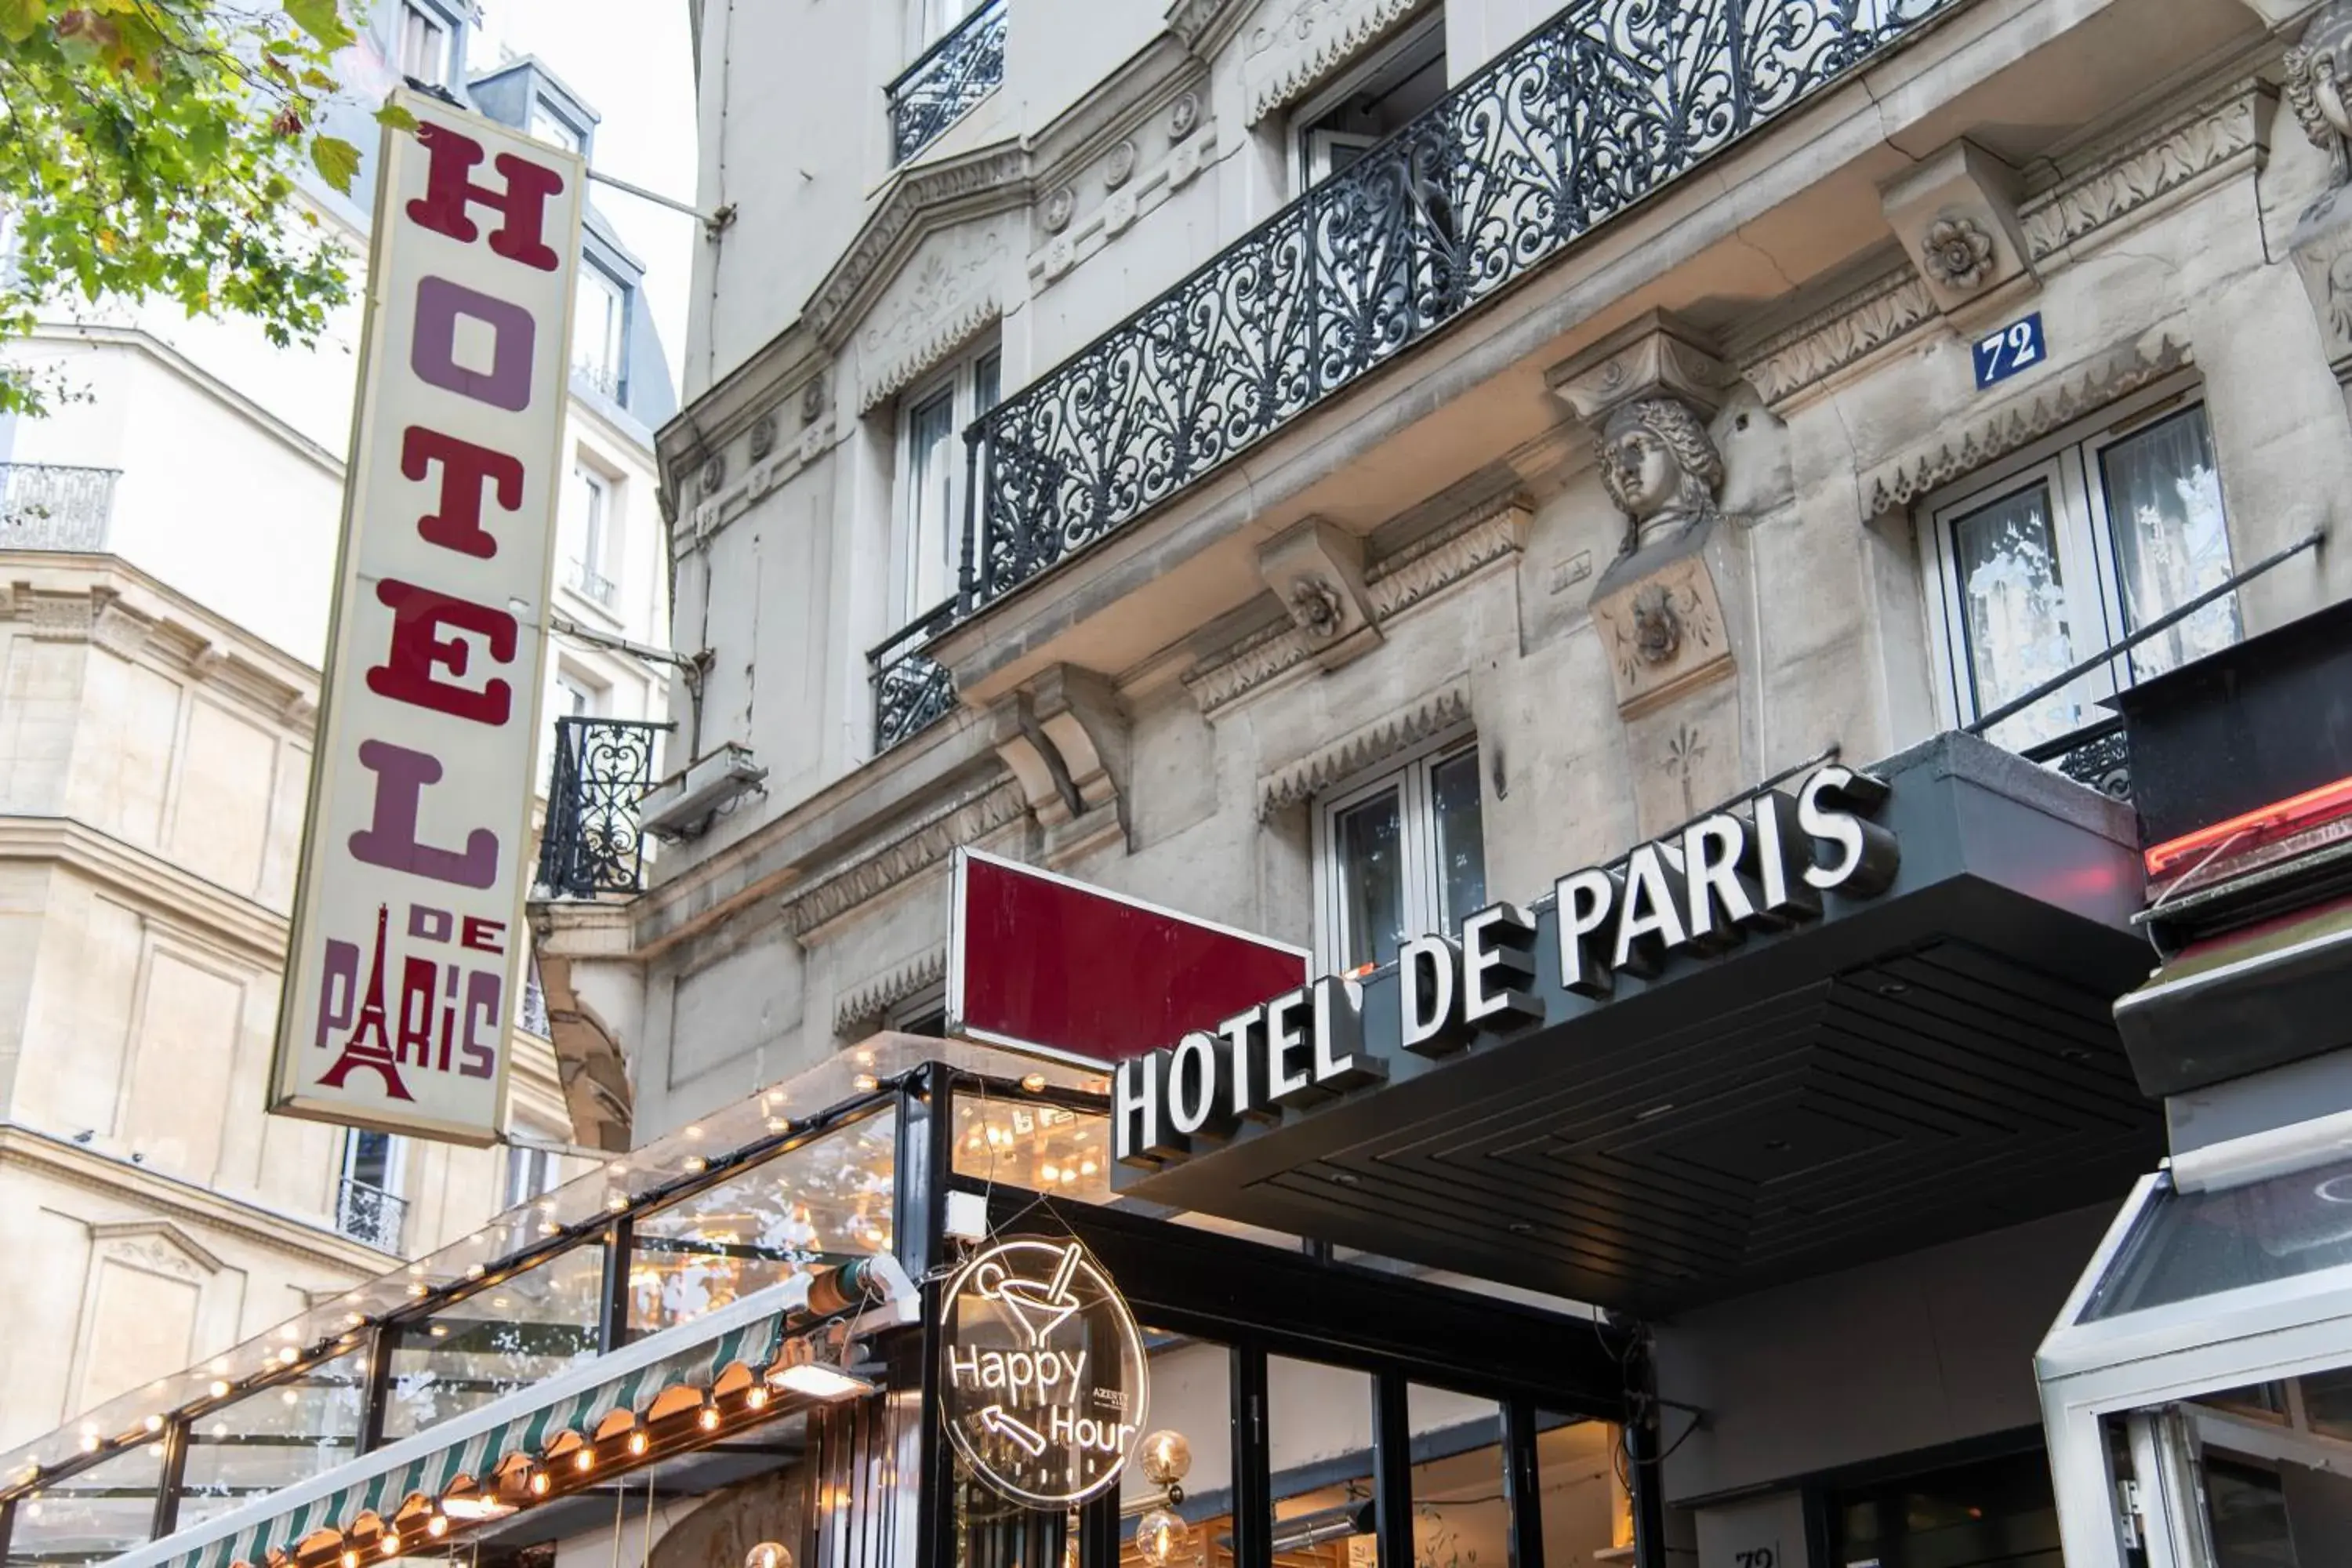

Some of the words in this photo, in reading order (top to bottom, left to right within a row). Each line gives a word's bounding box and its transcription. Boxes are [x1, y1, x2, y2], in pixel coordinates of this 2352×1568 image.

[1982, 322, 2035, 382] 72
[348, 120, 564, 891] HOTEL
[408, 903, 506, 955] DE
[1116, 976, 1354, 1160] HOTEL
[1399, 903, 1509, 1049] DE
[1555, 767, 1864, 991] PARIS
[949, 1343, 1087, 1406] Happy
[1051, 1406, 1135, 1453] Hour
